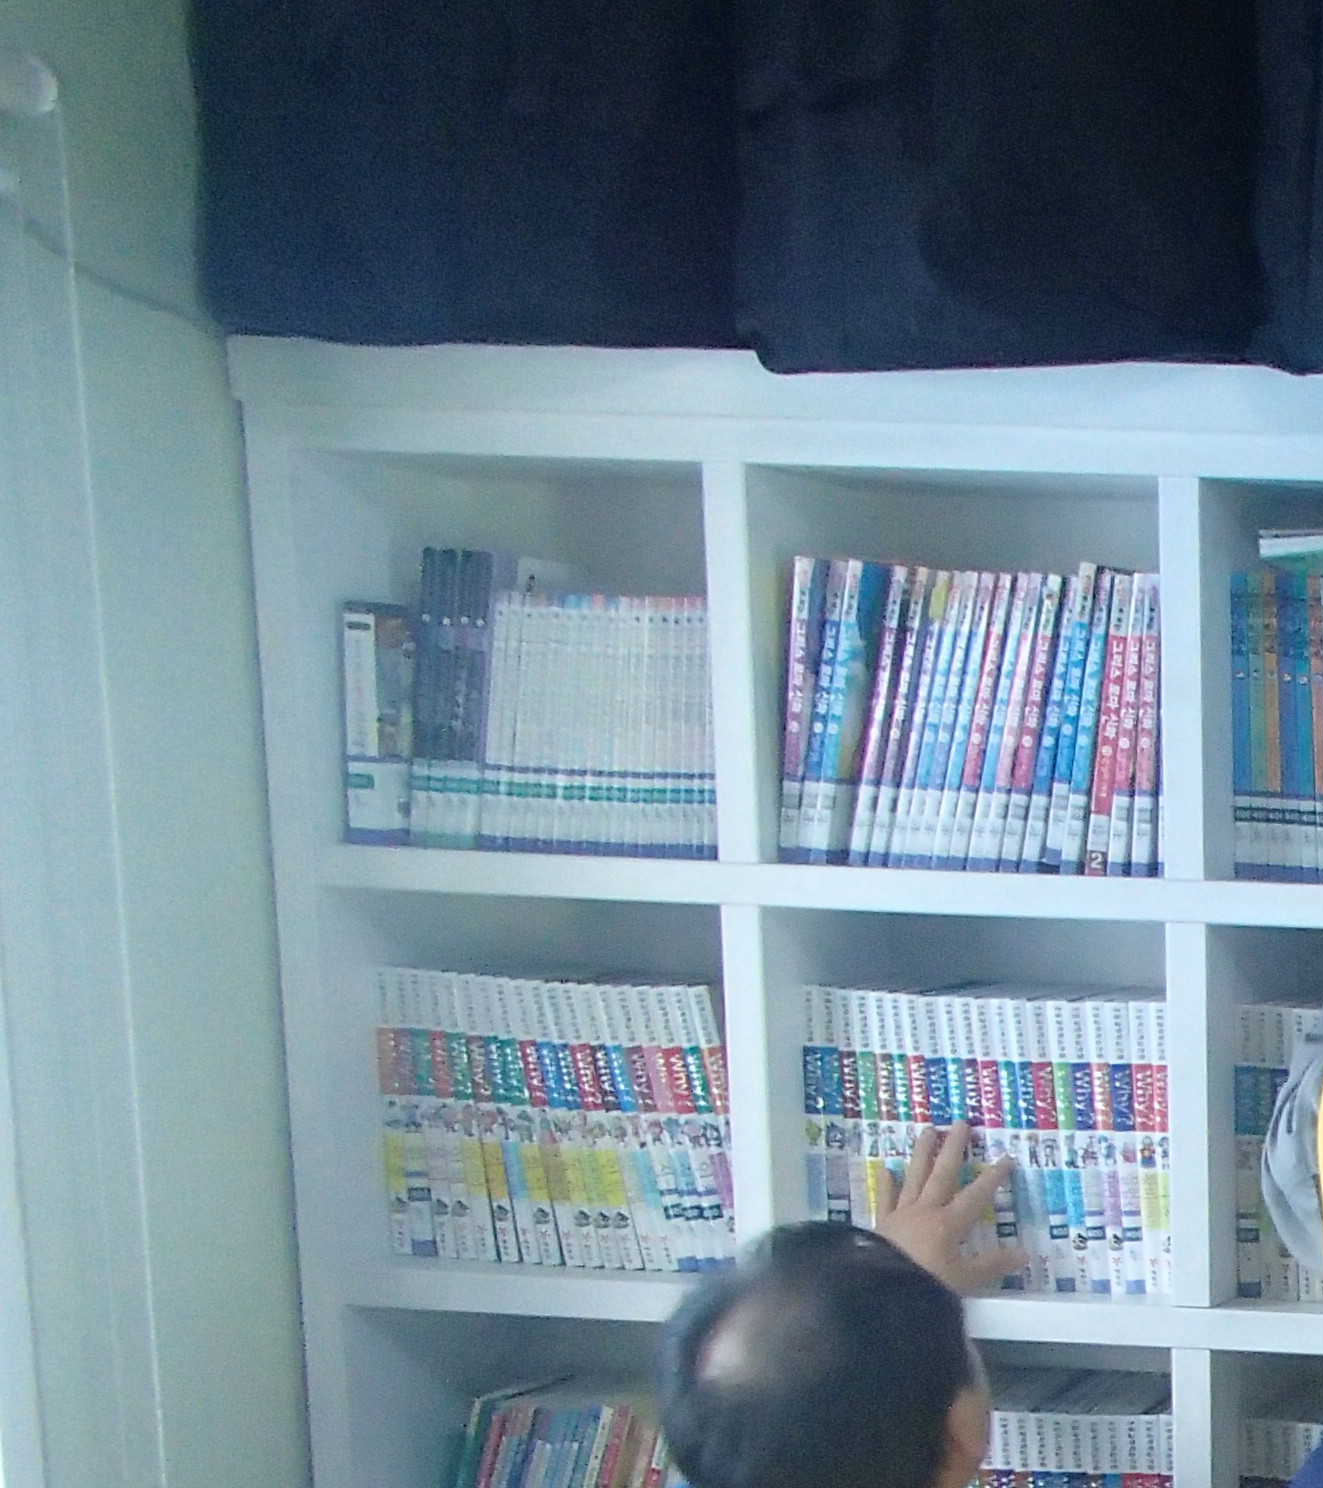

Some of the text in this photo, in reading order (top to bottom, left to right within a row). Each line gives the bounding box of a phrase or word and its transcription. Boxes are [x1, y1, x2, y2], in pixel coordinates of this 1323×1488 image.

[1090, 853, 1103, 868] 2
[930, 1063, 949, 1118] Why?
[982, 1066, 1002, 1122] Why?
[1036, 1066, 1056, 1122] Why?
[1075, 1069, 1095, 1124] Why?
[1115, 1070, 1134, 1125] Why?
[1134, 1070, 1153, 1125] Why?
